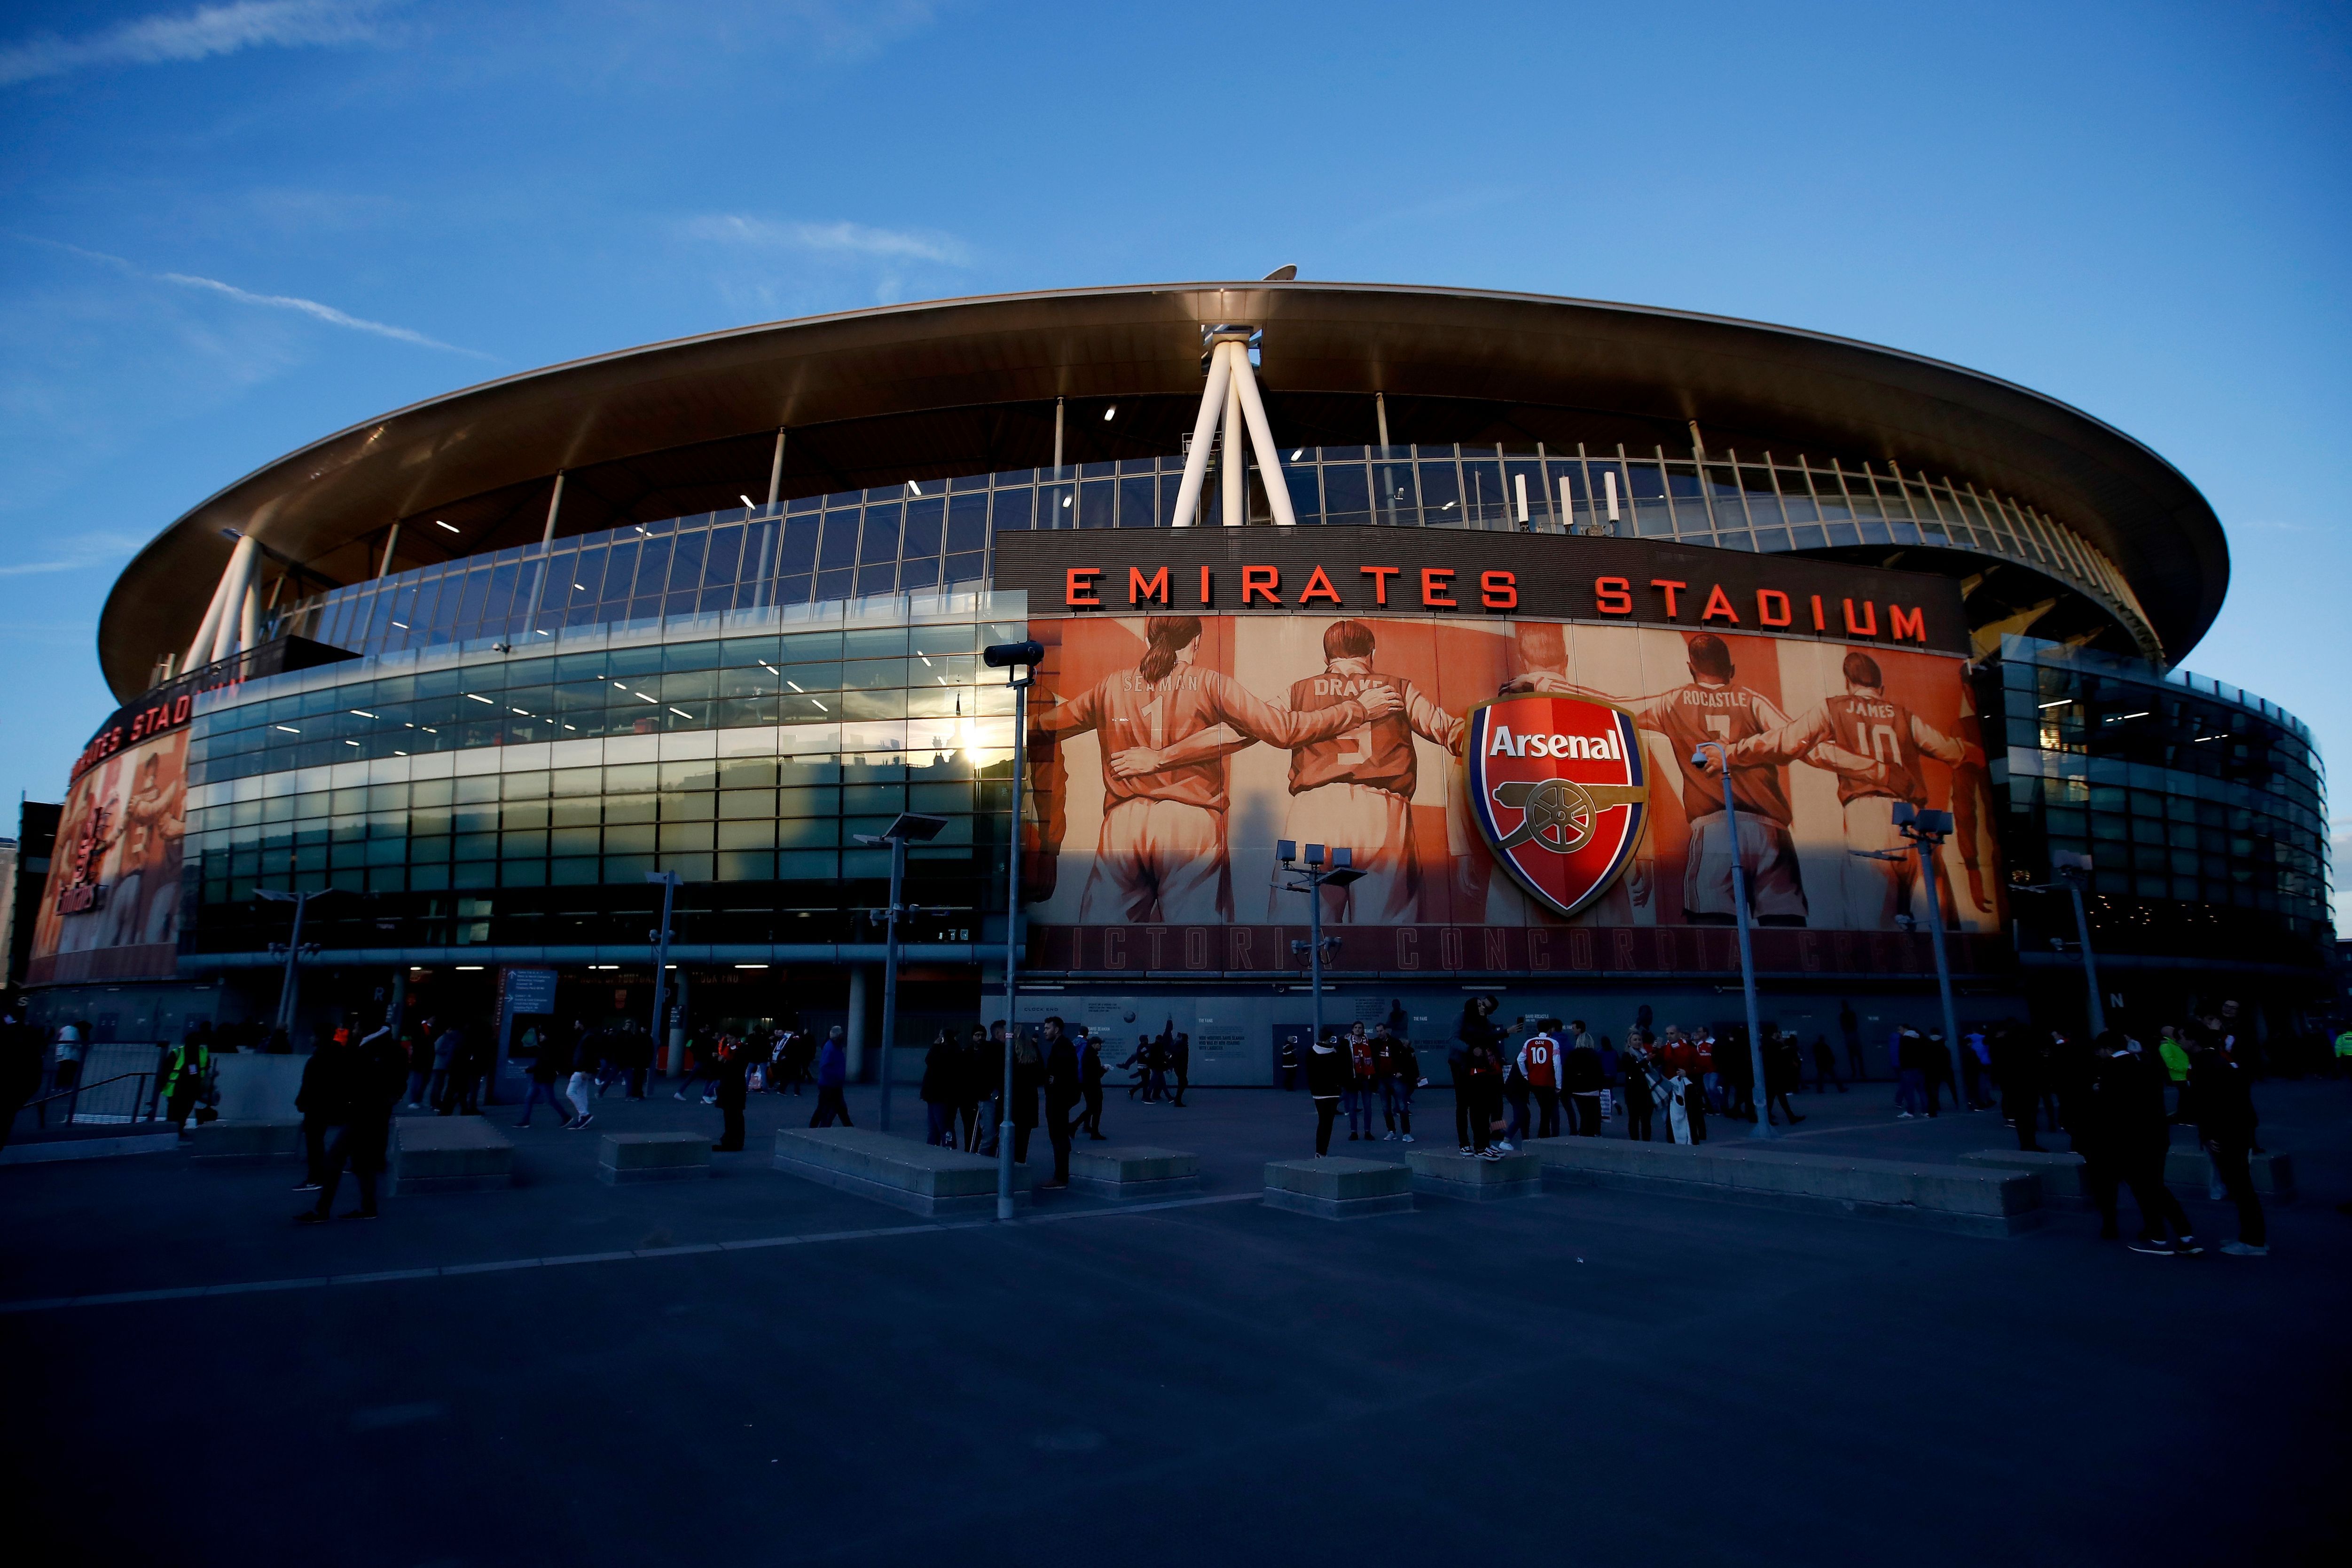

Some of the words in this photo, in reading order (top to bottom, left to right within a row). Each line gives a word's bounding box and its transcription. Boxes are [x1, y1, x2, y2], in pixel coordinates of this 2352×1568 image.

[1066, 565, 1517, 608] EMIRATES
[1596, 577, 1926, 641] STADIUM
[1123, 675, 1198, 692] SEAMAN
[1683, 690, 1747, 707] ROCASTLE
[1846, 700, 1895, 718] JAMES
[1141, 694, 1163, 751] 1
[1489, 725, 1622, 760] Arsenal
[1857, 722, 1903, 767] 10
[374, 987, 384, 1001] R
[2109, 993, 2124, 1008] N
[1530, 1046, 1547, 1064] 10
